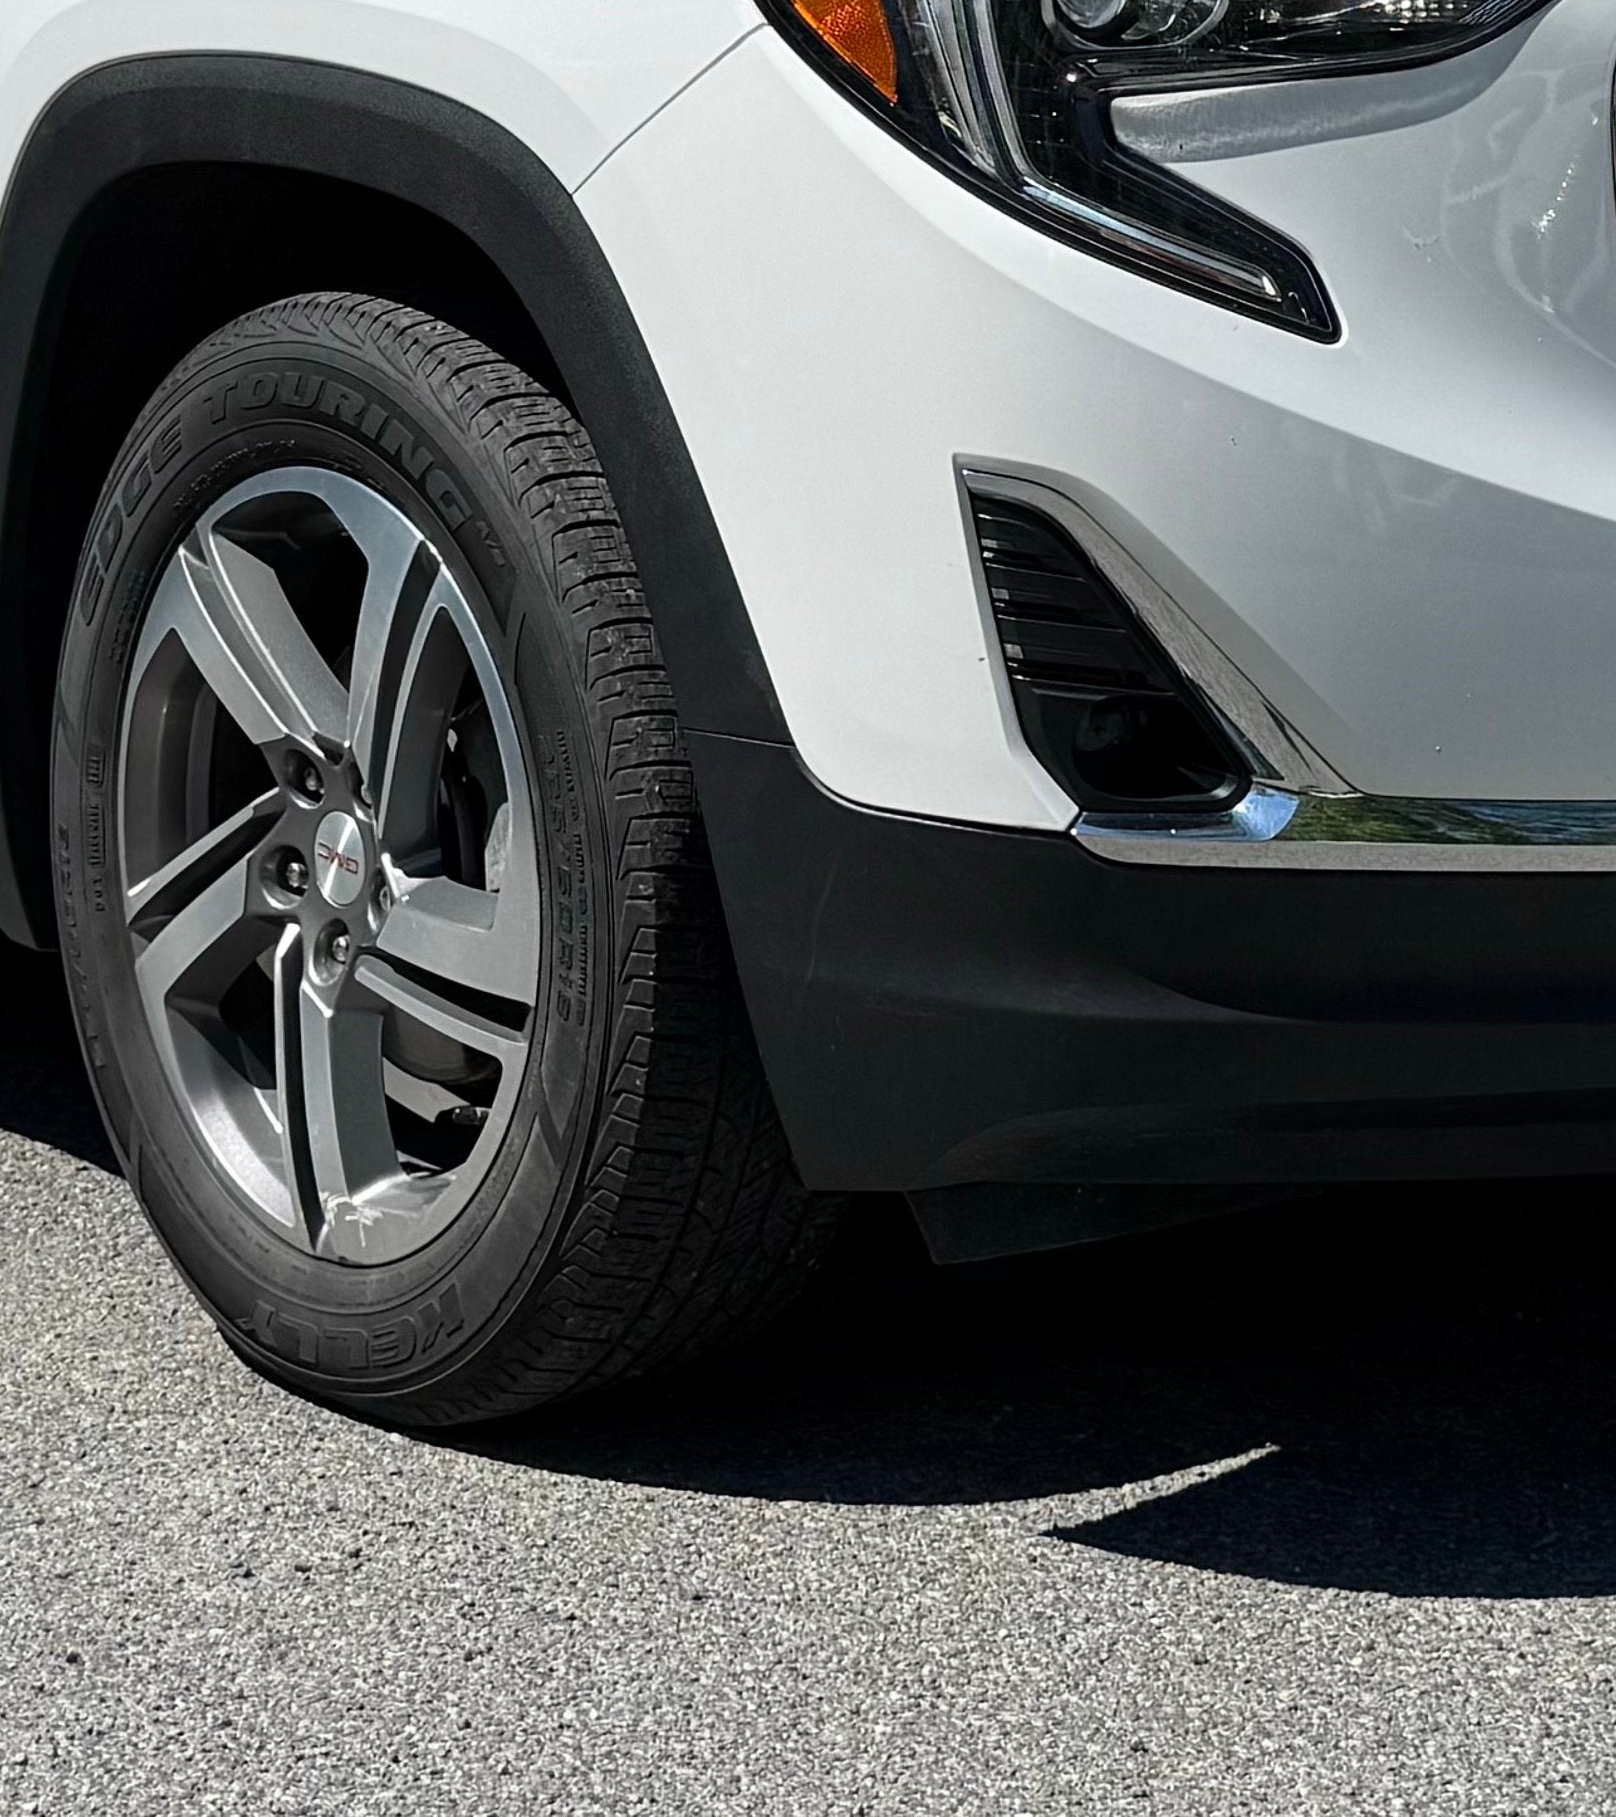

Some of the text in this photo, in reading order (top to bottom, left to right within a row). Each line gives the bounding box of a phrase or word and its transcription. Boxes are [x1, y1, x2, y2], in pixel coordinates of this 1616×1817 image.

[79, 415, 184, 626] EDGE
[203, 371, 474, 531] TOURING
[317, 840, 360, 875] GMC
[232, 1281, 466, 1370] KELLY
